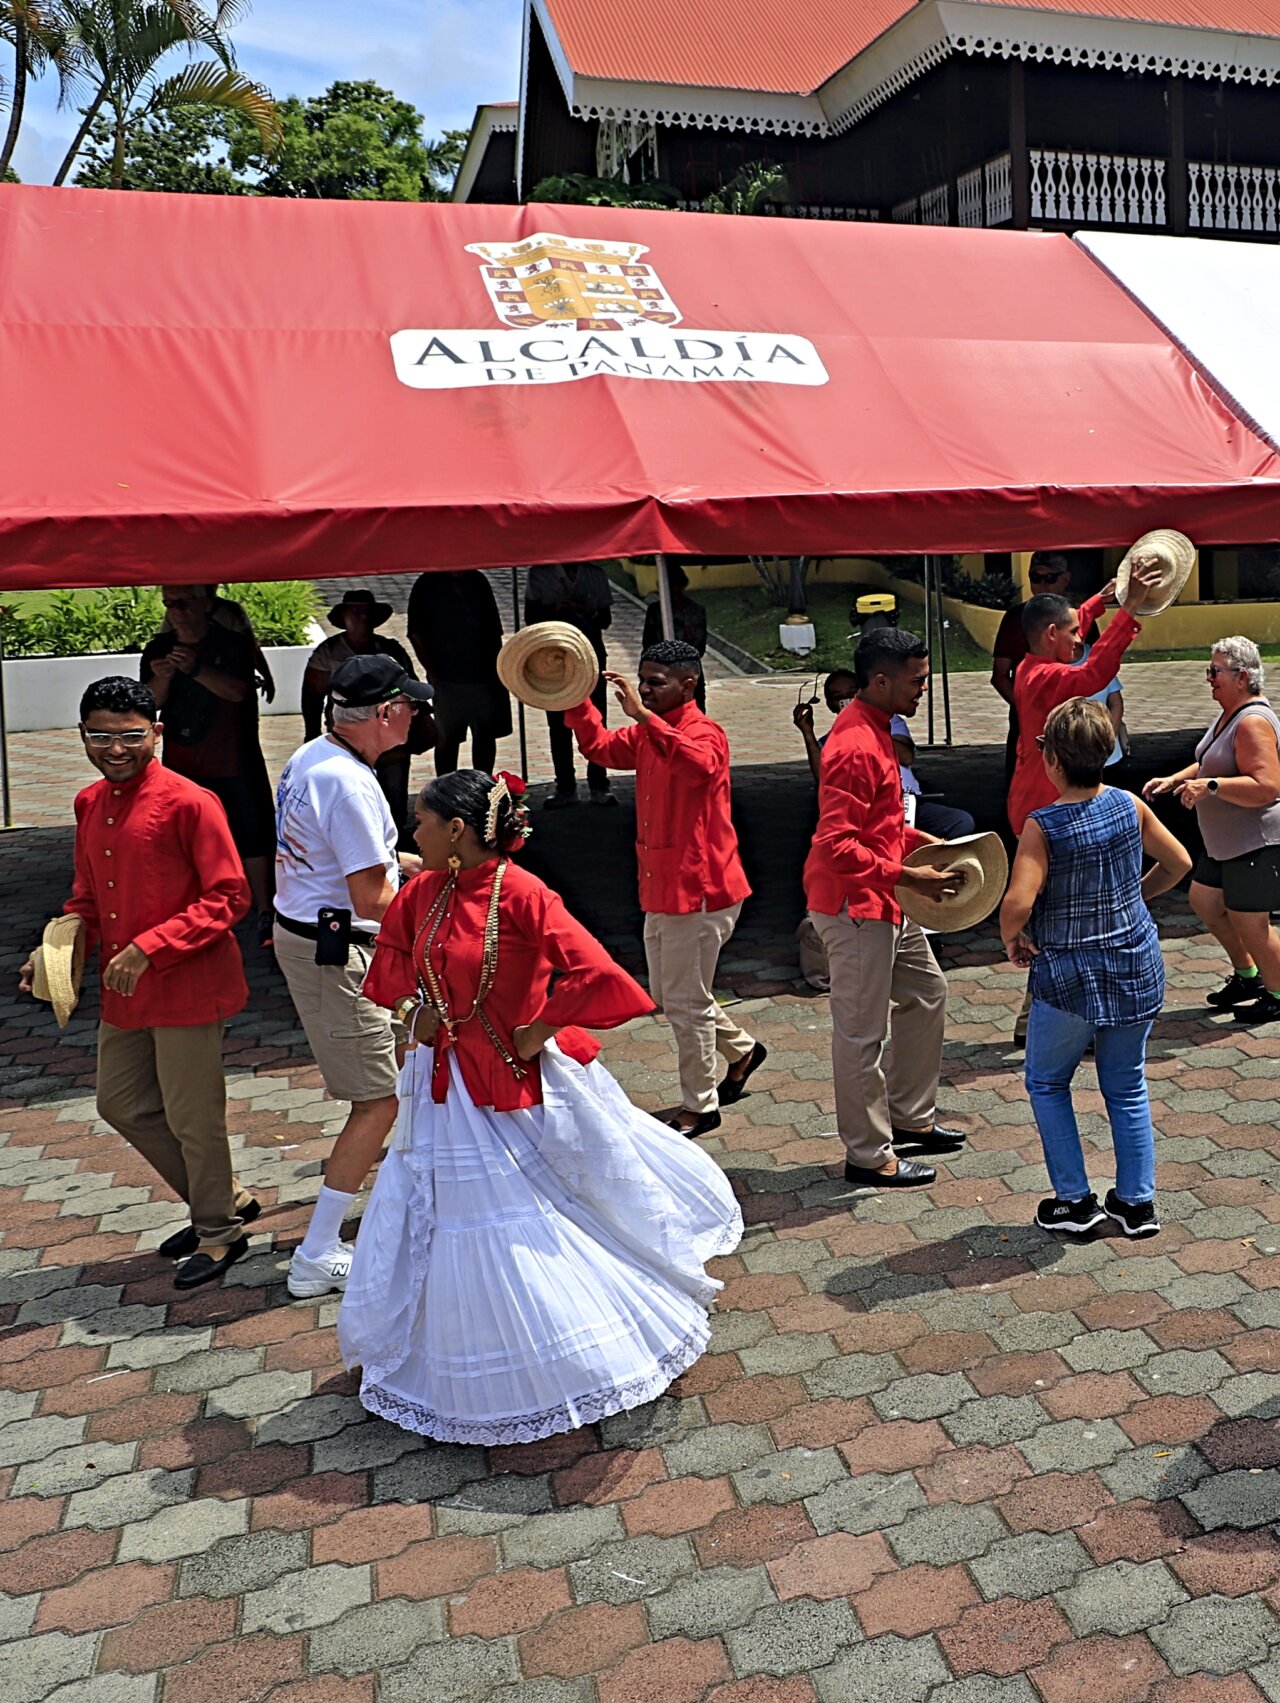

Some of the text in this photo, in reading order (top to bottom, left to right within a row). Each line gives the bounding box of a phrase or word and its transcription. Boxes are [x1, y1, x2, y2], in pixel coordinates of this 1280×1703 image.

[409, 335, 808, 366] ALCALDÍA
[485, 360, 756, 381] DE PANAMÁ
